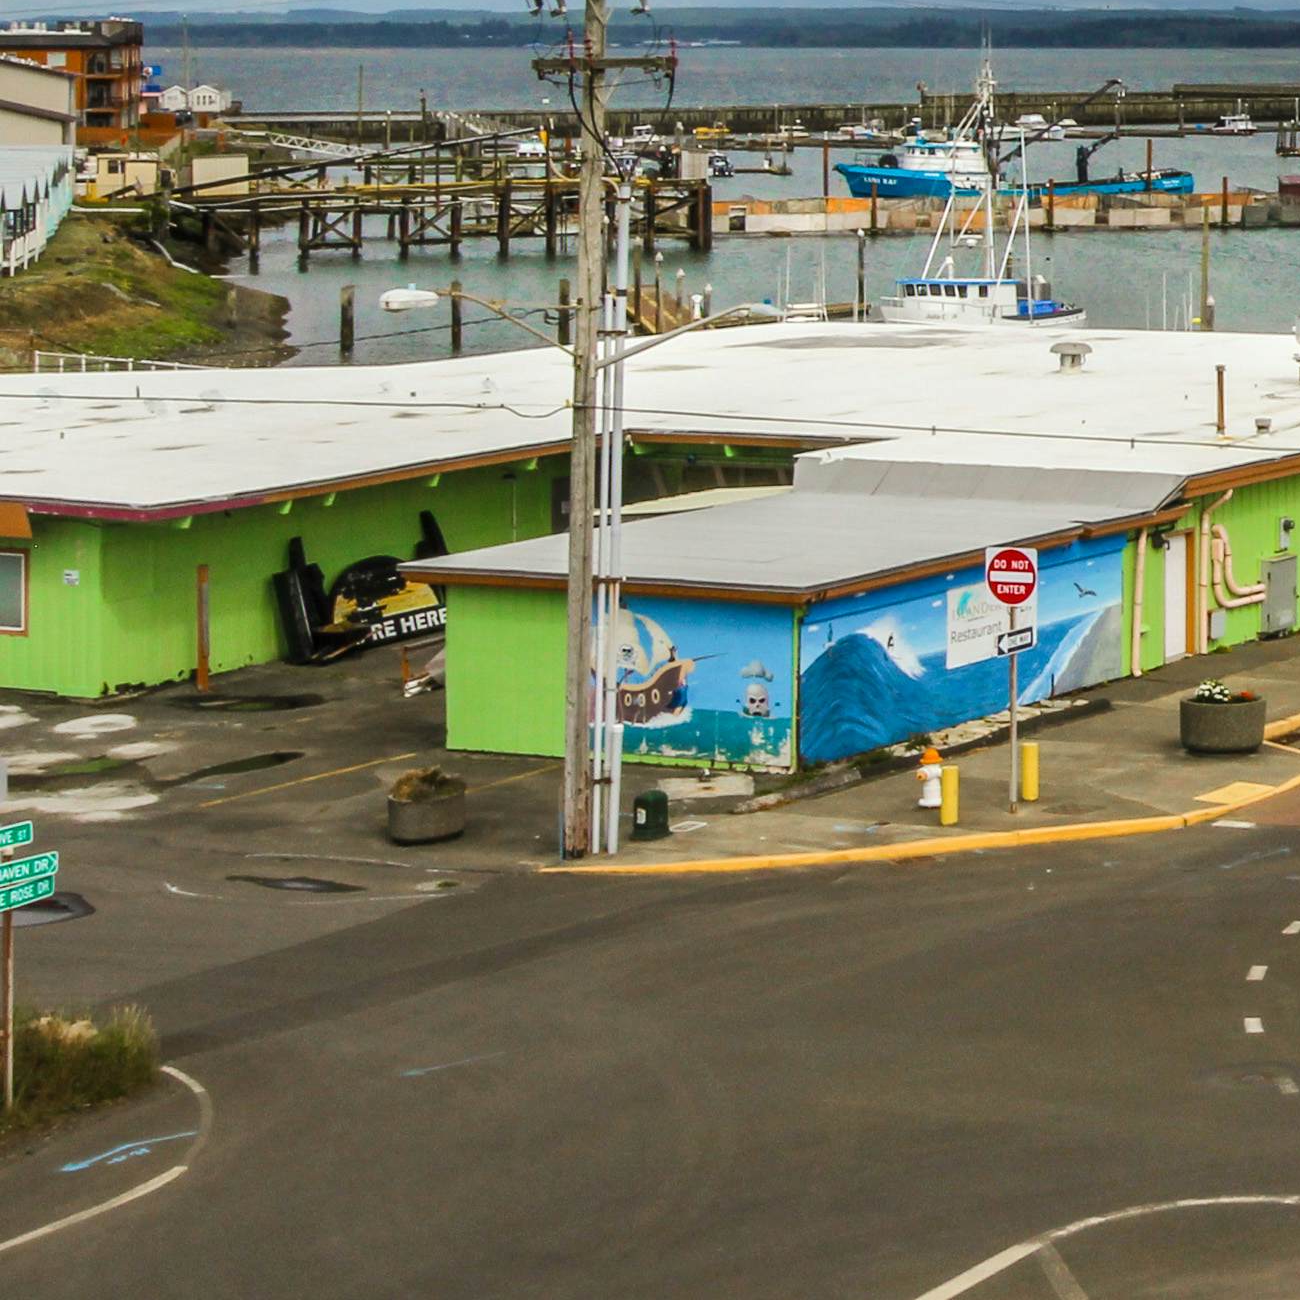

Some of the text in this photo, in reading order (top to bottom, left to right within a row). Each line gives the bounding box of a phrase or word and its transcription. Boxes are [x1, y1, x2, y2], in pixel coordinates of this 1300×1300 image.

[994, 559, 1029, 570] DO NOT
[997, 584, 1026, 595] ENTER
[369, 607, 447, 641] RE HERE
[950, 620, 1003, 644] Restaurant
[0, 830, 14, 844] VE
[34, 859, 49, 873] DR
[10, 884, 34, 904] ROSE
[37, 880, 50, 895] DR
